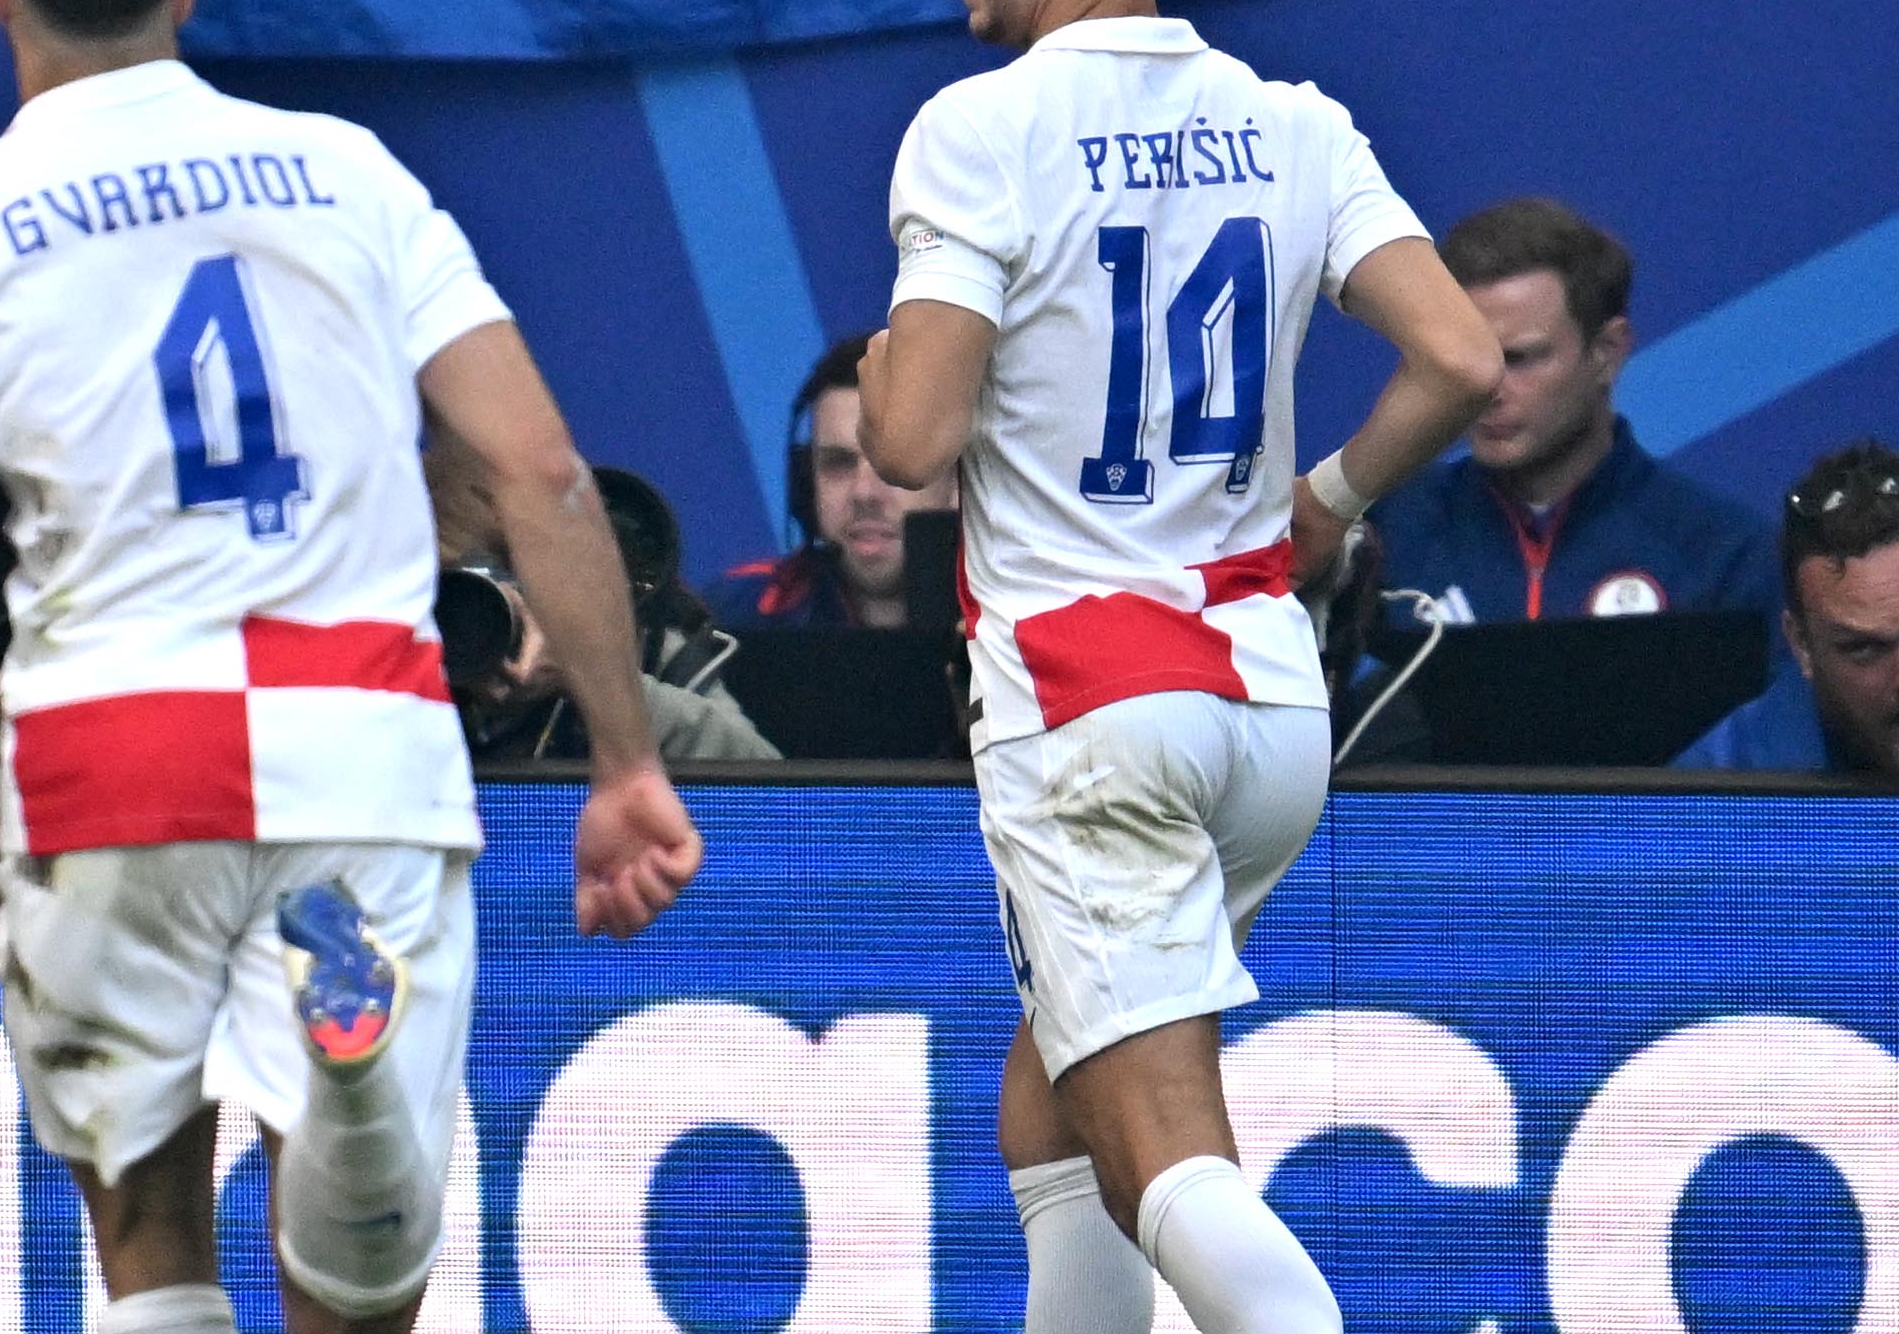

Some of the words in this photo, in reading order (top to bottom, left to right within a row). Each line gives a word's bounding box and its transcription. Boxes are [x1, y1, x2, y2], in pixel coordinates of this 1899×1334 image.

[0, 153, 336, 257] GVARDIOL
[152, 250, 312, 541] 4
[1078, 216, 1276, 505] 14
